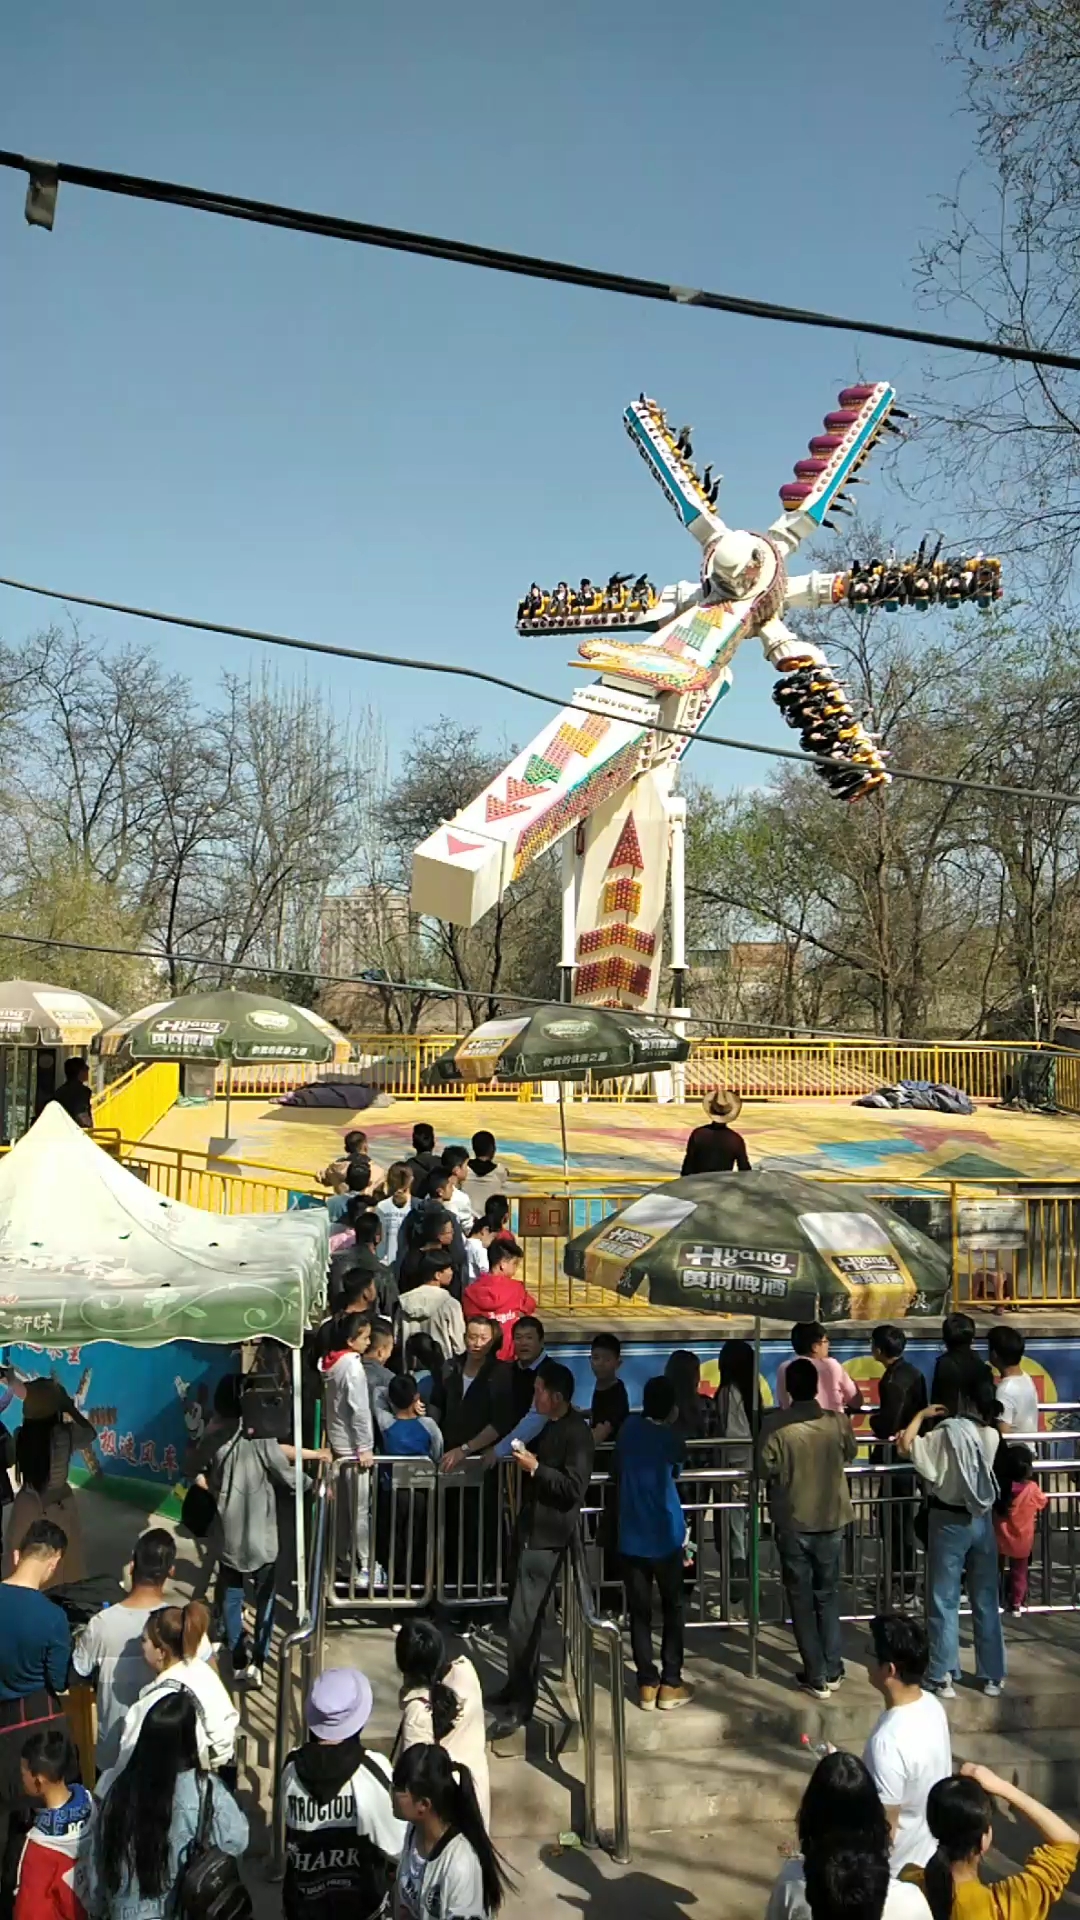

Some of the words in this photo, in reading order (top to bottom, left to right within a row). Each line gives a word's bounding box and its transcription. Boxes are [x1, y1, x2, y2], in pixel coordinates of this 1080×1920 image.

[526, 1207, 561, 1227] 进口
[682, 1270, 788, 1297] 黄河啤酒
